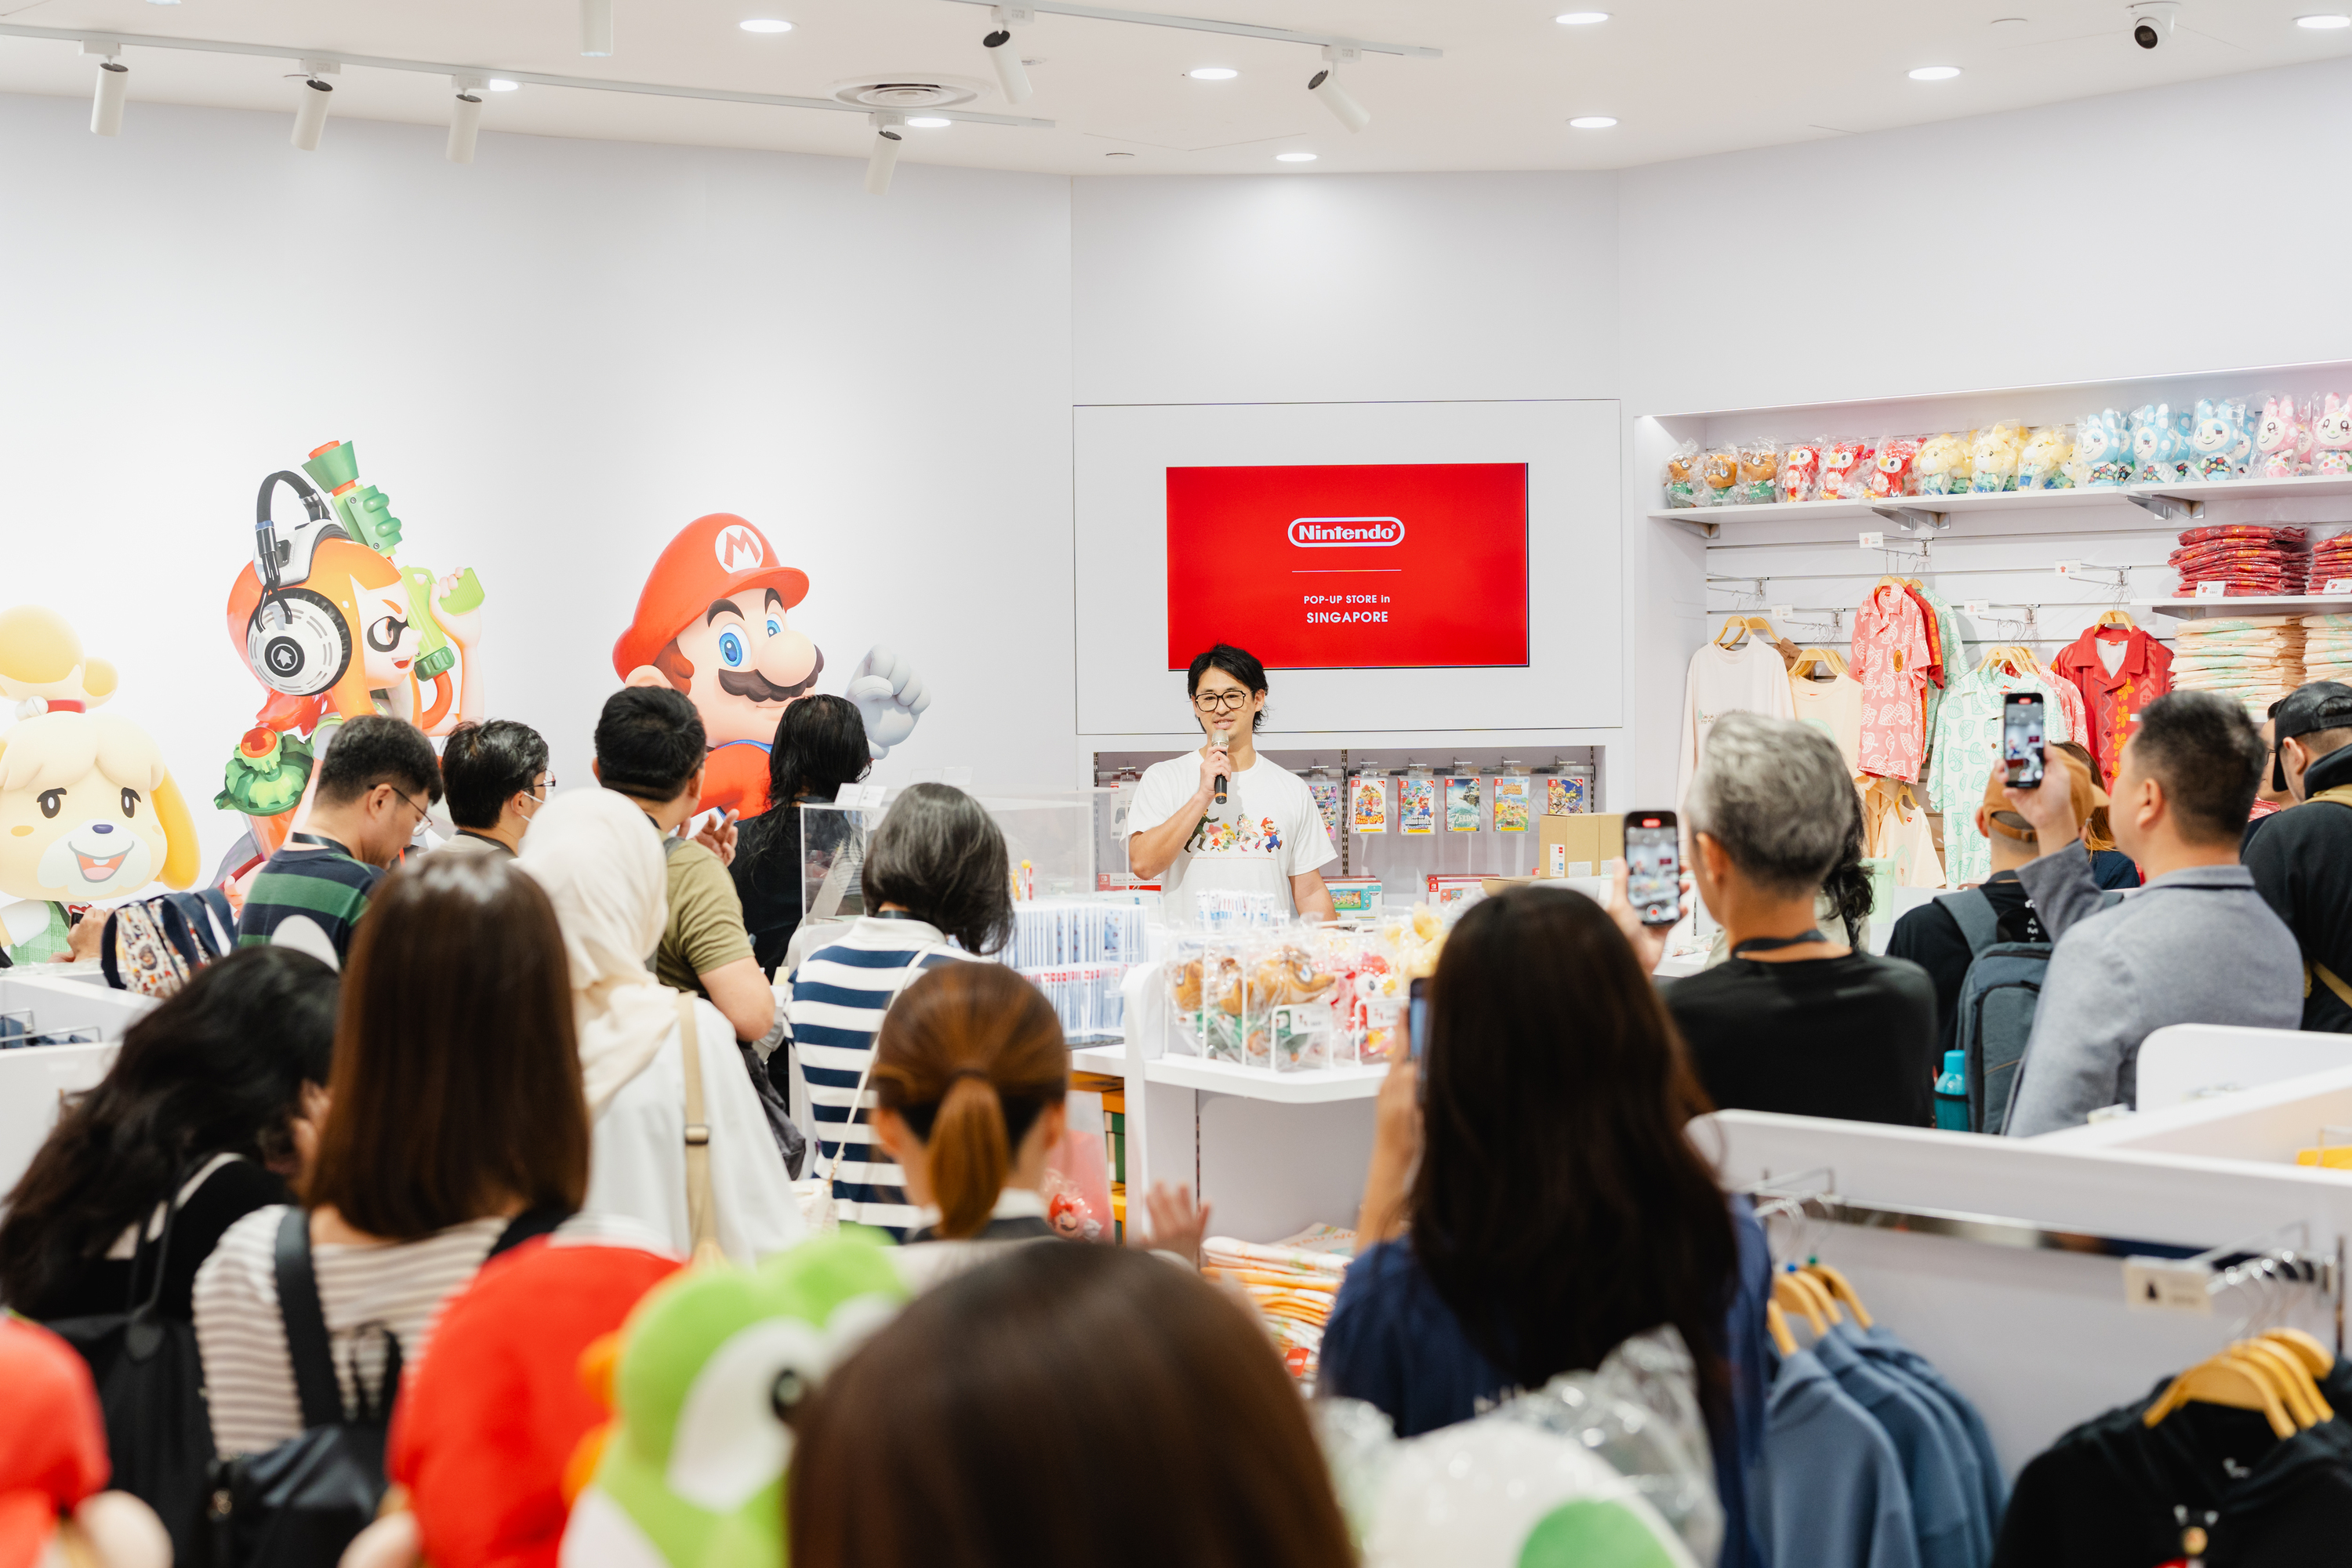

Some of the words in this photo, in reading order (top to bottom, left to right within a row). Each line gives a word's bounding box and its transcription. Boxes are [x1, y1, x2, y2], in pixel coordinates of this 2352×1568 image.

[724, 528, 761, 568] M
[1303, 595, 1343, 604] POP-UP
[1345, 594, 1377, 604] STORE
[1381, 594, 1391, 603] in
[1306, 611, 1388, 623] SINGAPORE
[1369, 815, 1383, 824] RPG
[1451, 814, 1475, 824] ZELDA
